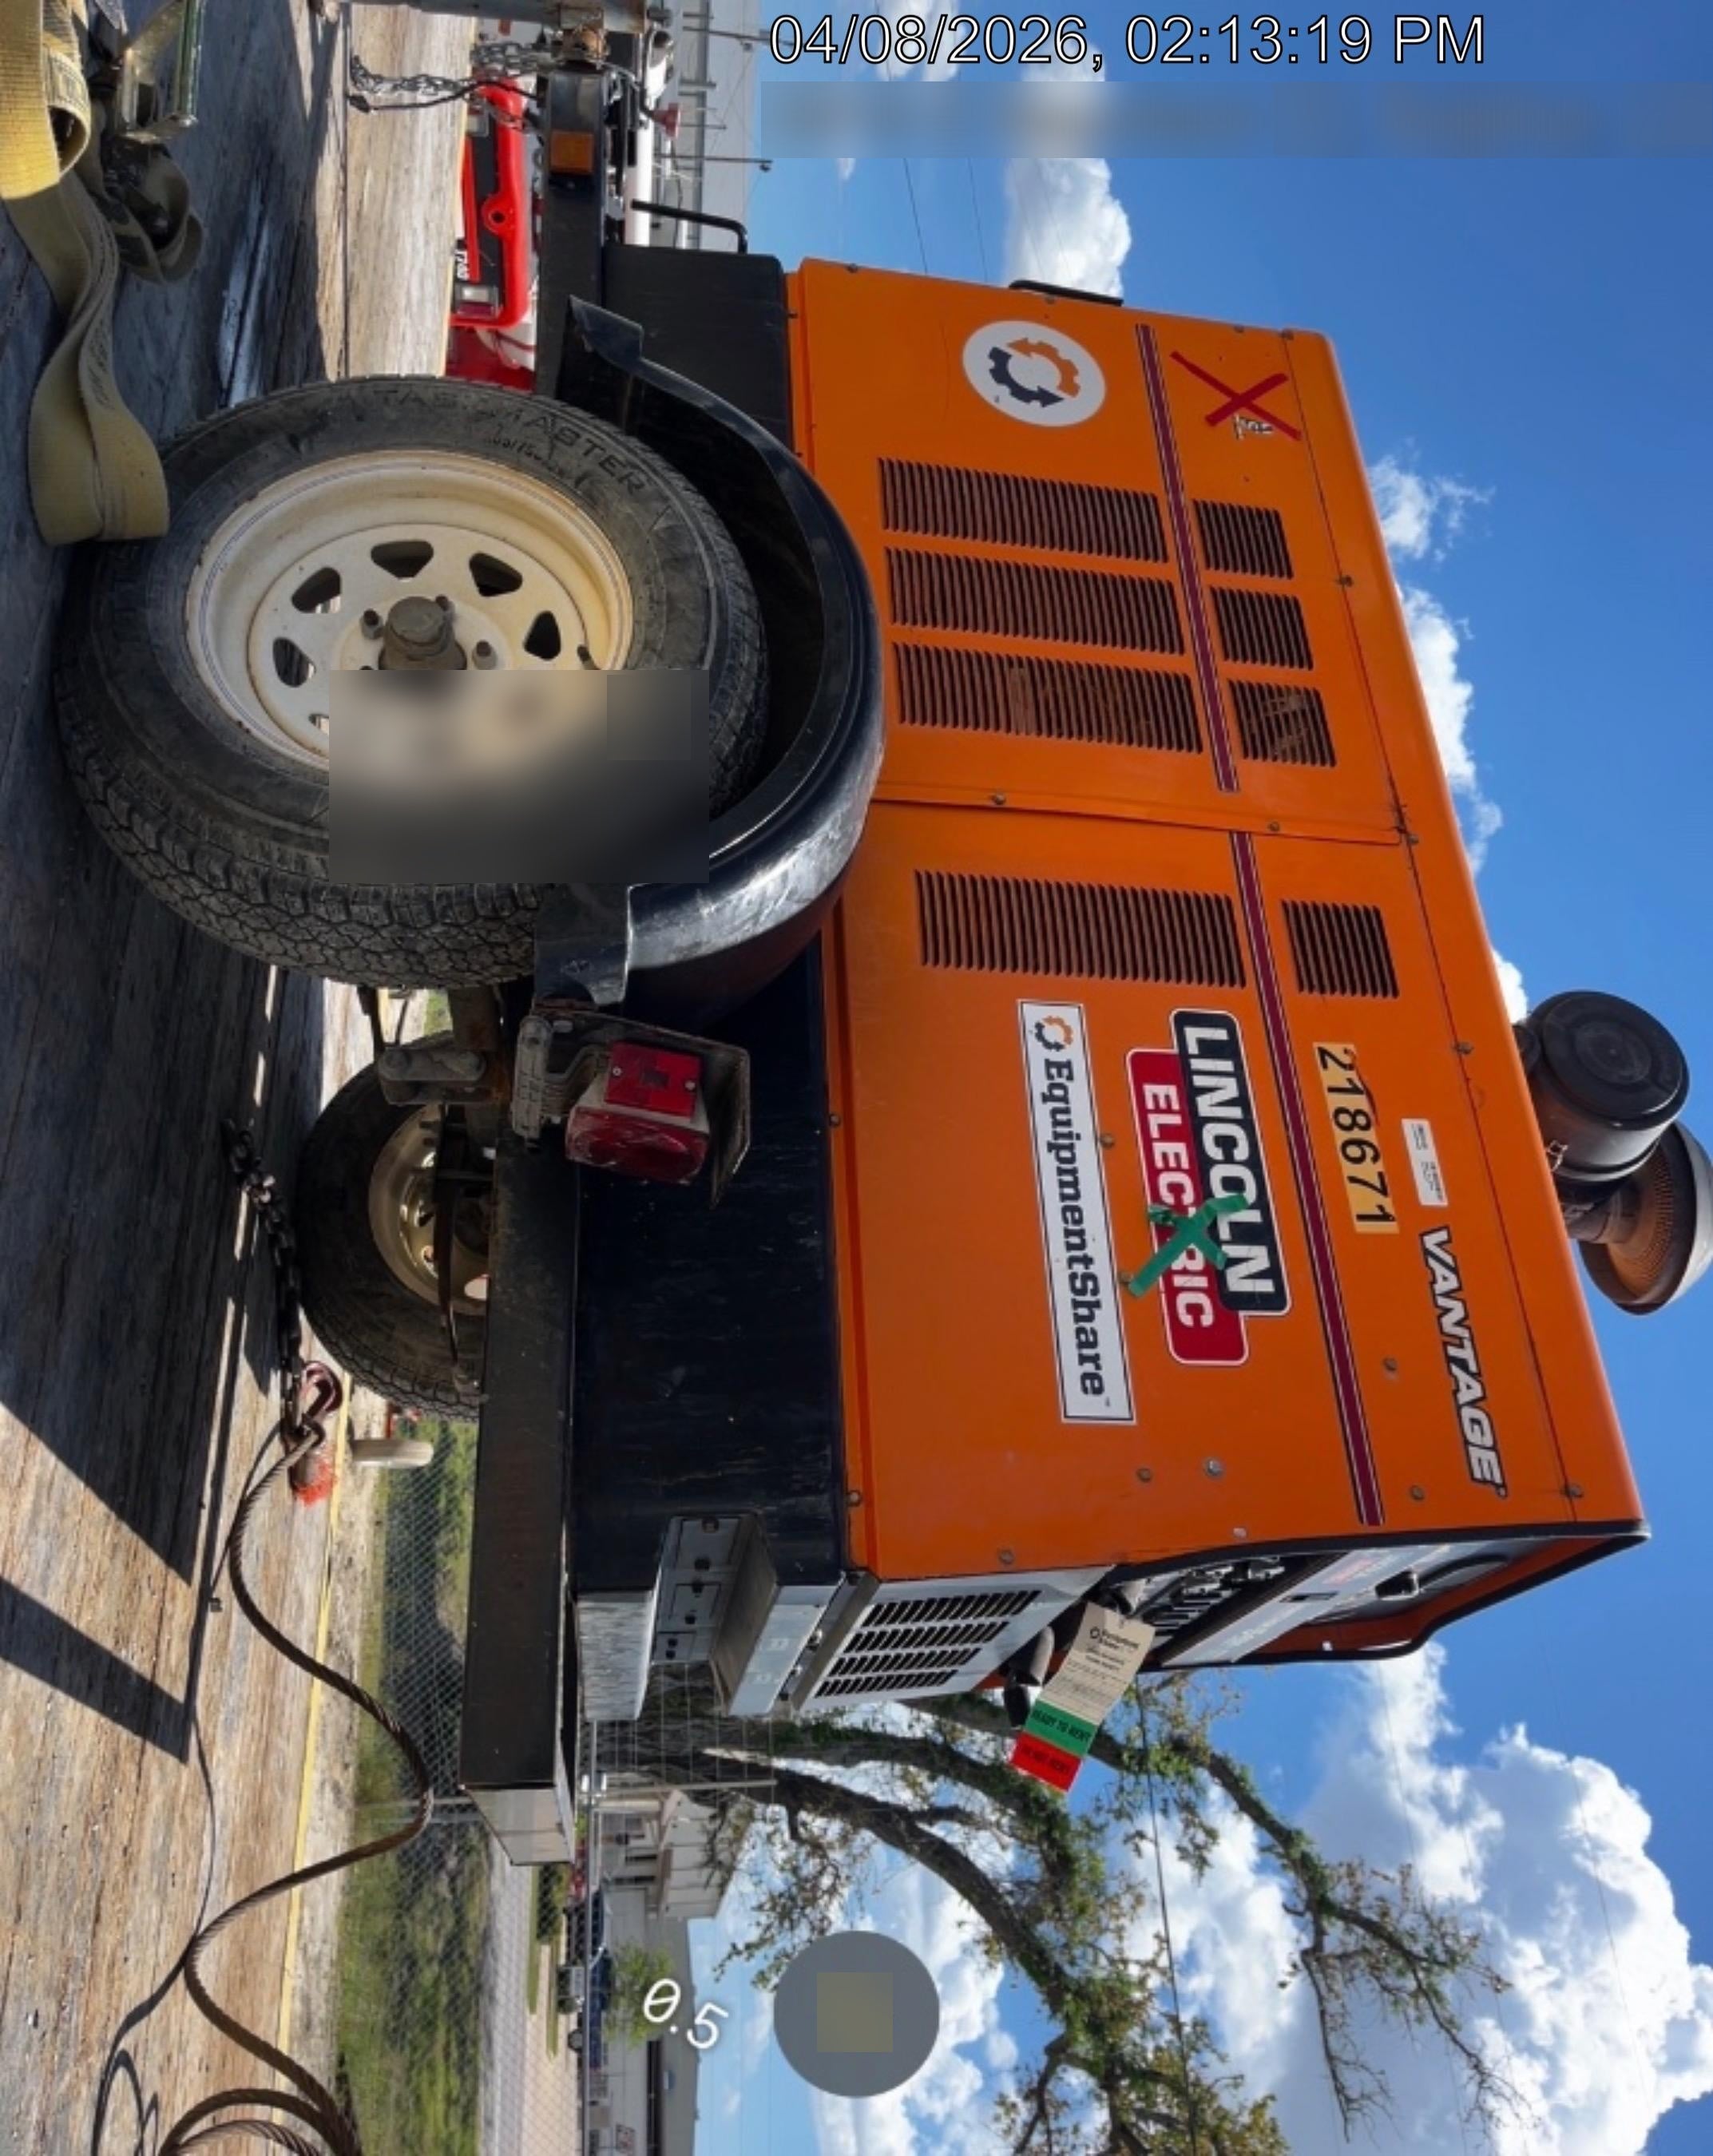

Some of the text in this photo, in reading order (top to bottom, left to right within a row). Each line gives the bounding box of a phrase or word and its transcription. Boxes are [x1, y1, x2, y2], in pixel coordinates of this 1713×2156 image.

[1041, 1058, 1106, 1397] EquipmentShare
[1142, 1083, 1216, 1329] ELECRIC
[1183, 1024, 1276, 1294] LINCOLN
[1316, 1045, 1397, 1223] 218671
[1420, 1226, 1505, 1488] VANTAGE
